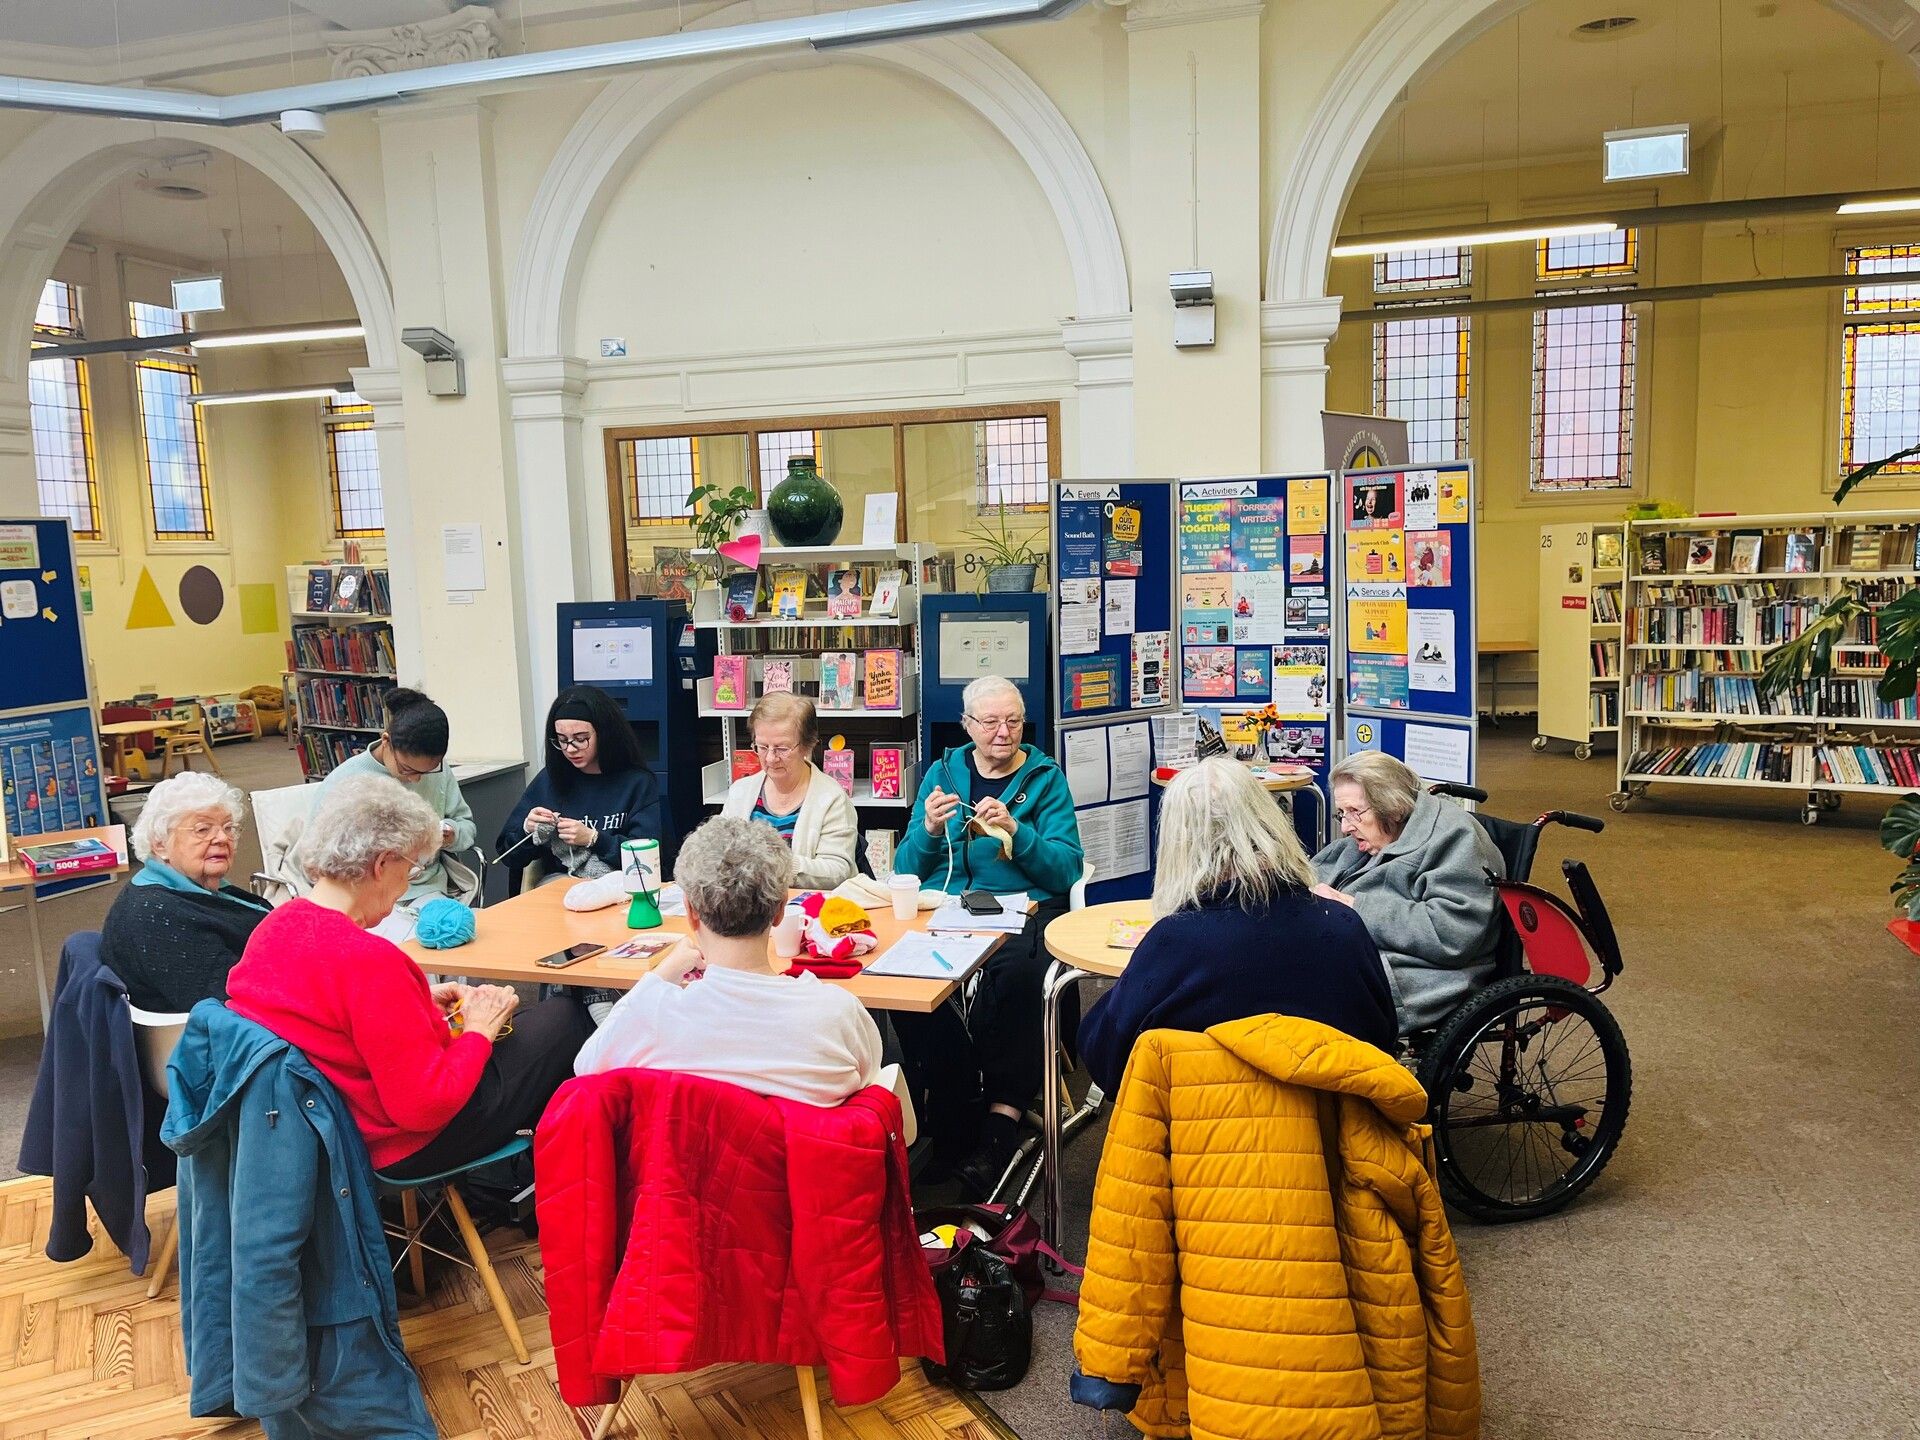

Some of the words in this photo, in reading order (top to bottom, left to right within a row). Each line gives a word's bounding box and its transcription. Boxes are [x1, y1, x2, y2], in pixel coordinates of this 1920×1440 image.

[1078, 490, 1100, 498] Events
[1202, 487, 1238, 496] Activities
[1184, 503, 1226, 513] TUESDAY
[1238, 503, 1280, 511] TORRIDON
[1196, 514, 1213, 522] GET
[1240, 515, 1277, 524] WRITERS
[1116, 524, 1136, 532] NIGHT
[1180, 524, 1230, 534] TOGETHER
[1541, 535, 1552, 548] 25
[1576, 532, 1588, 546] 20
[964, 554, 975, 573] 8
[314, 576, 324, 605] DEEP
[1362, 588, 1390, 596] Services
[870, 678, 891, 686] where
[876, 756, 888, 765] We
[882, 762, 896, 772] Just
[874, 771, 898, 783] Clicked
[56, 861, 73, 870] 500
